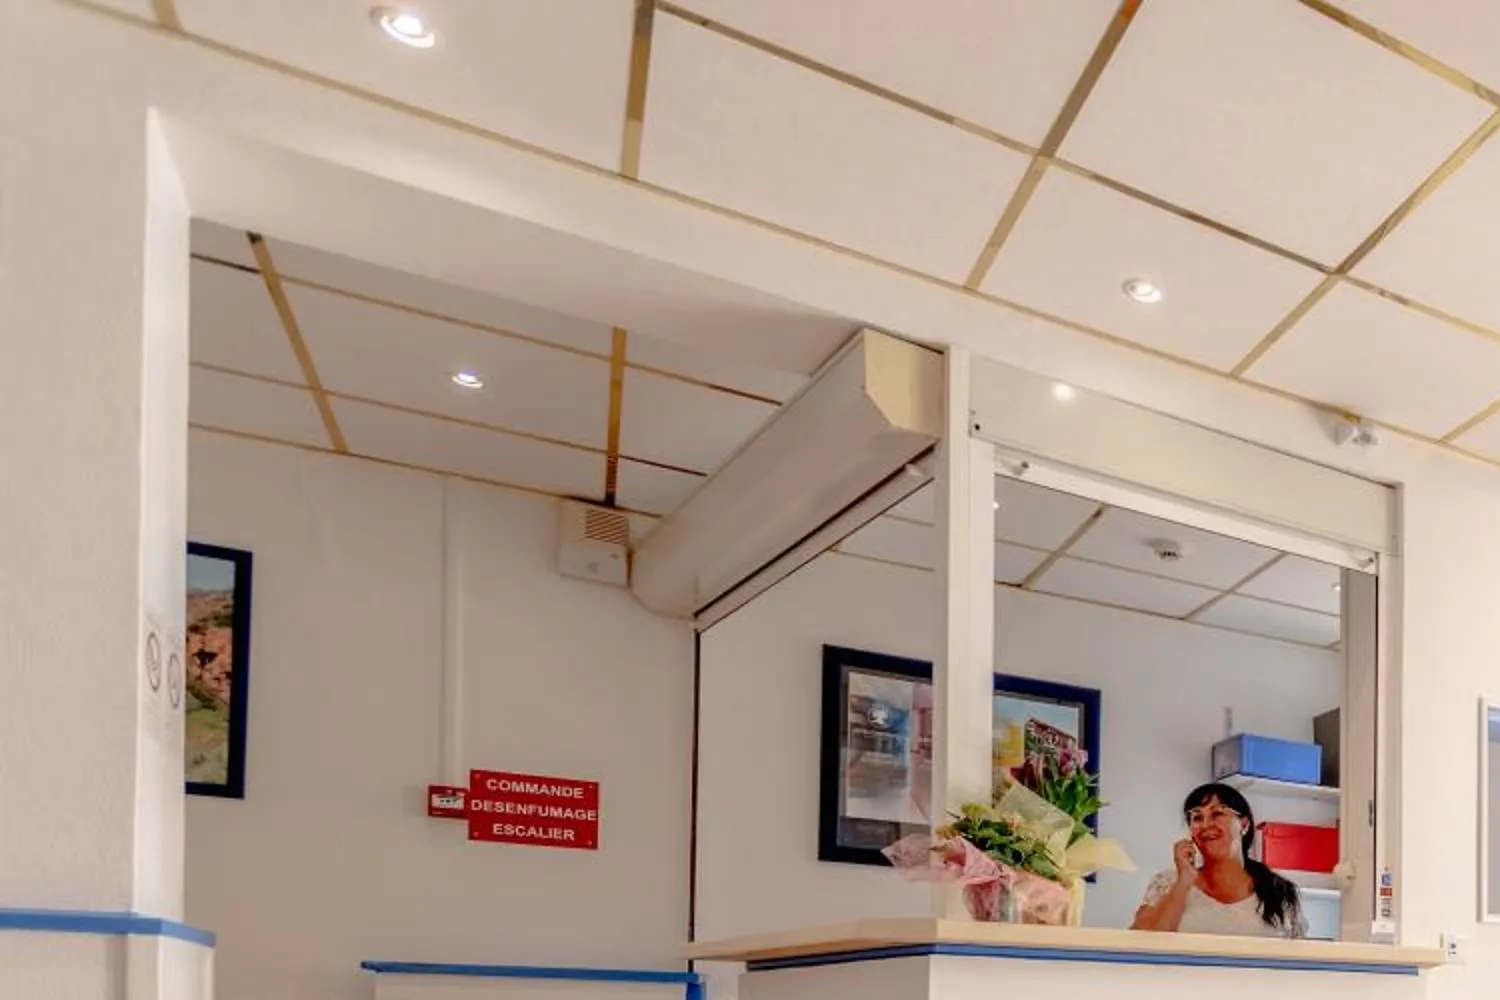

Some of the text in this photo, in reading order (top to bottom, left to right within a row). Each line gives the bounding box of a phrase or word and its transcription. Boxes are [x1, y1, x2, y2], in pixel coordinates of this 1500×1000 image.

[486, 779, 584, 798] COMMANDE
[471, 799, 597, 821] DESENFUMAGE
[492, 823, 575, 840] ESCALIER
